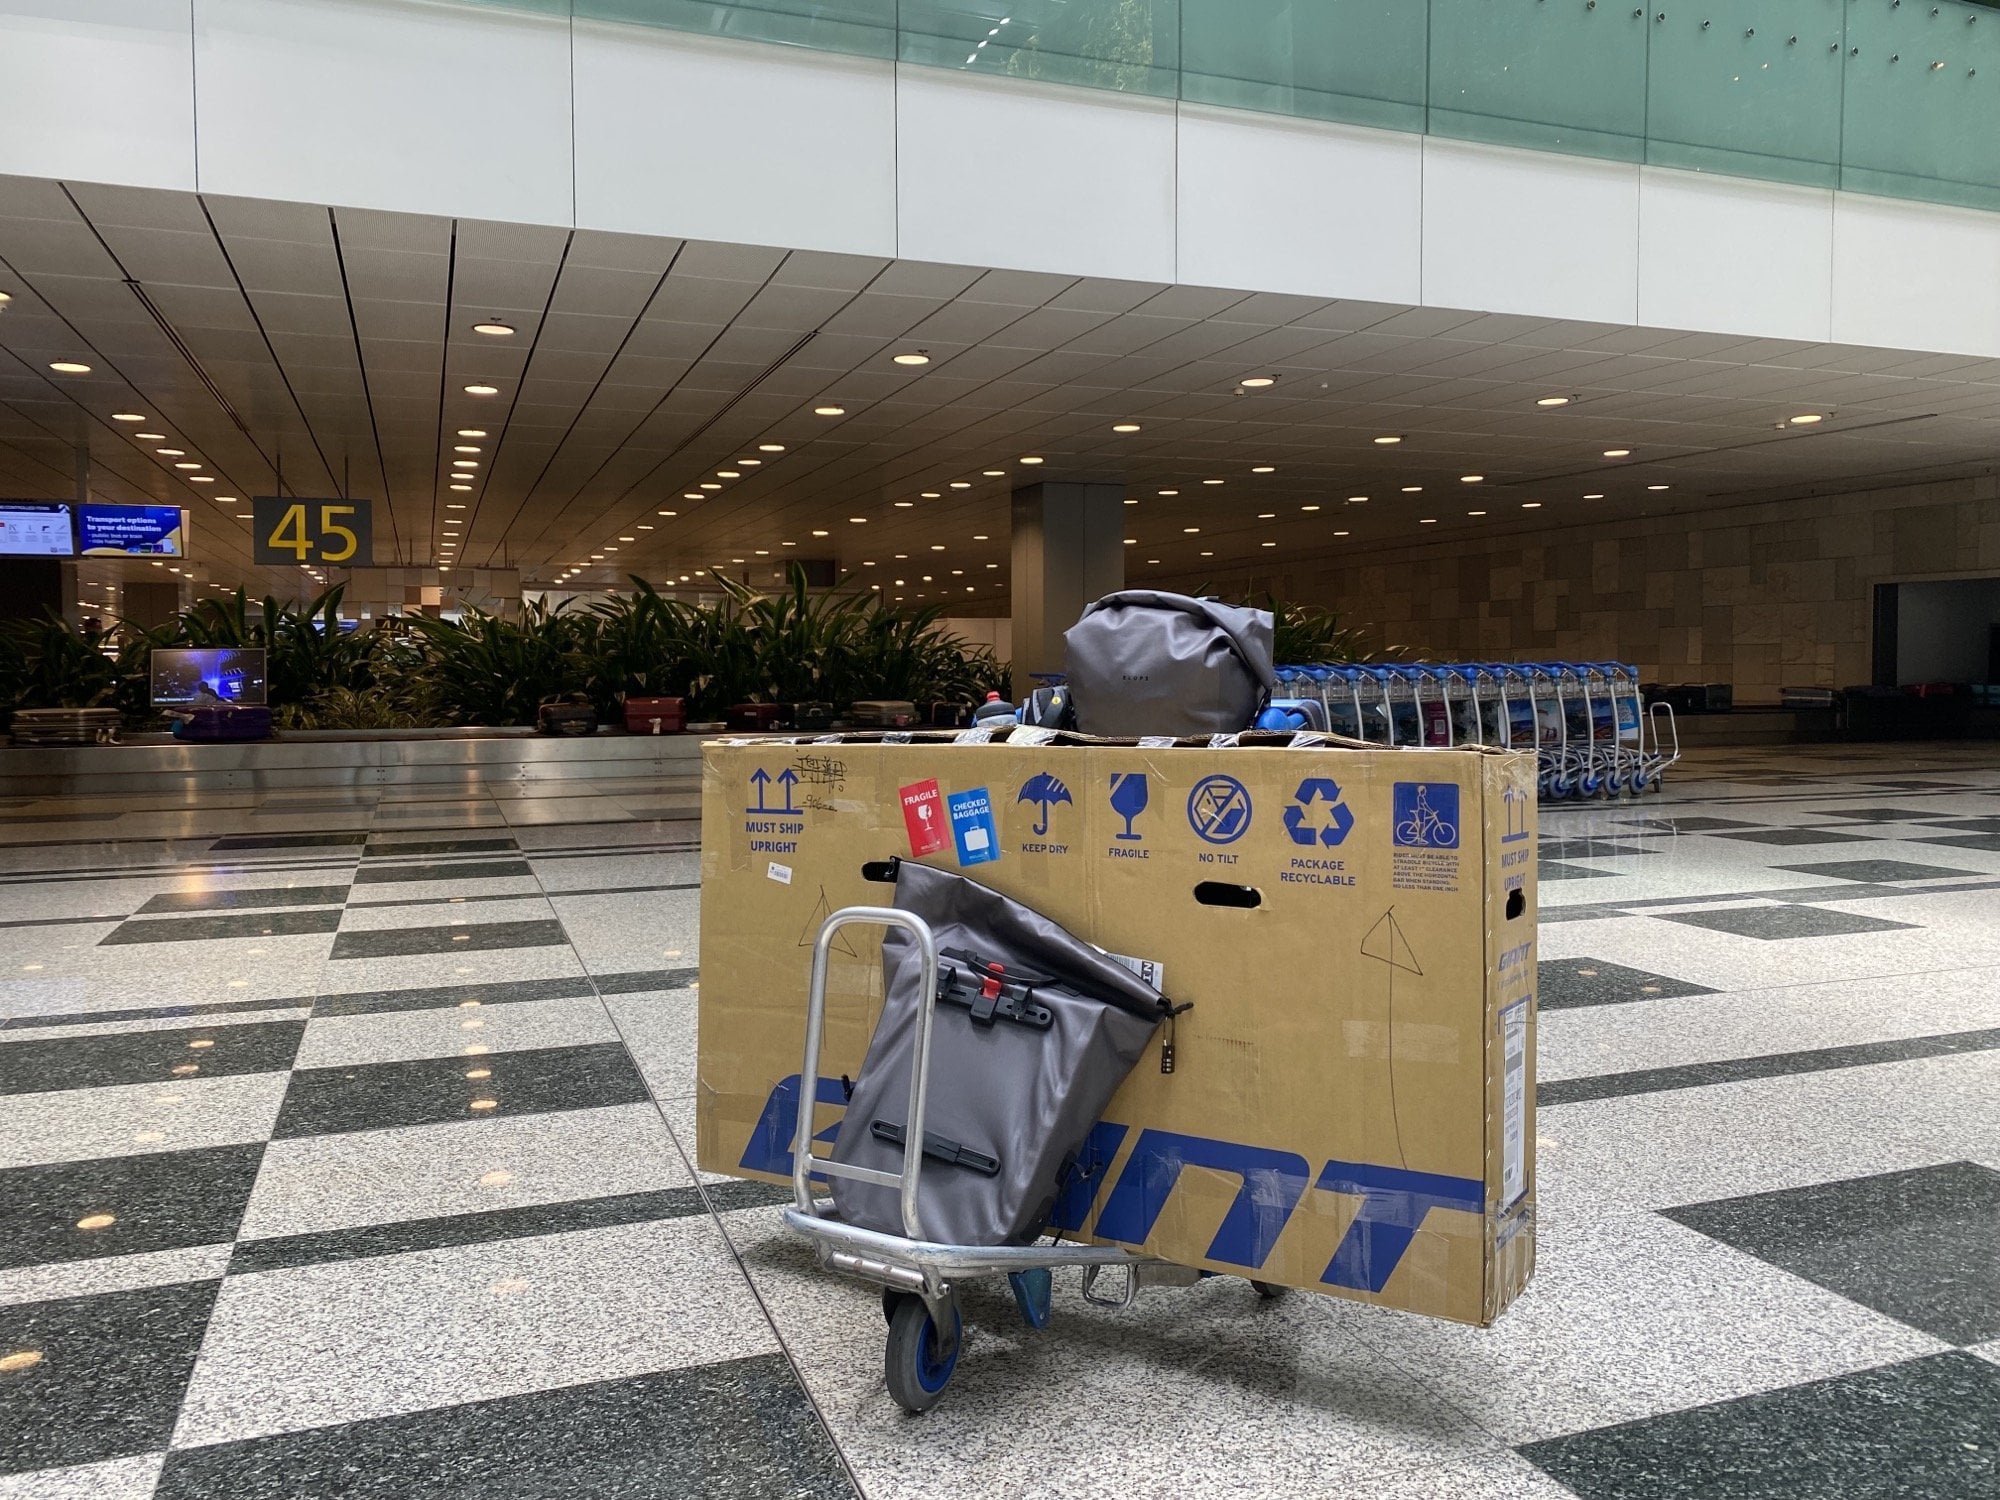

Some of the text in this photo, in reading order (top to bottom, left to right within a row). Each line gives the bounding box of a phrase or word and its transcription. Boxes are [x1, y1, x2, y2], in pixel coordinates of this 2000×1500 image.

[86, 516, 157, 525] Transport options
[268, 504, 357, 562] 45
[904, 789, 938, 806] FRAGILE
[952, 798, 987, 812] CHECKED
[953, 806, 990, 820] BAGGAGE
[746, 821, 804, 835] MUST SHIP
[750, 840, 798, 853] UPRIGHT
[1022, 843, 1069, 855] KEEP DRY
[1108, 847, 1150, 859] FRAGILE
[1198, 853, 1239, 865] NO TILT
[1290, 858, 1345, 872] PACKAGE
[1502, 848, 1530, 868] MUST SHIP
[1280, 873, 1356, 887] RECYCLABLE
[1504, 872, 1526, 890] UPRIGHT
[1498, 941, 1532, 972] GIANT
[739, 1074, 1484, 1293] GNT
